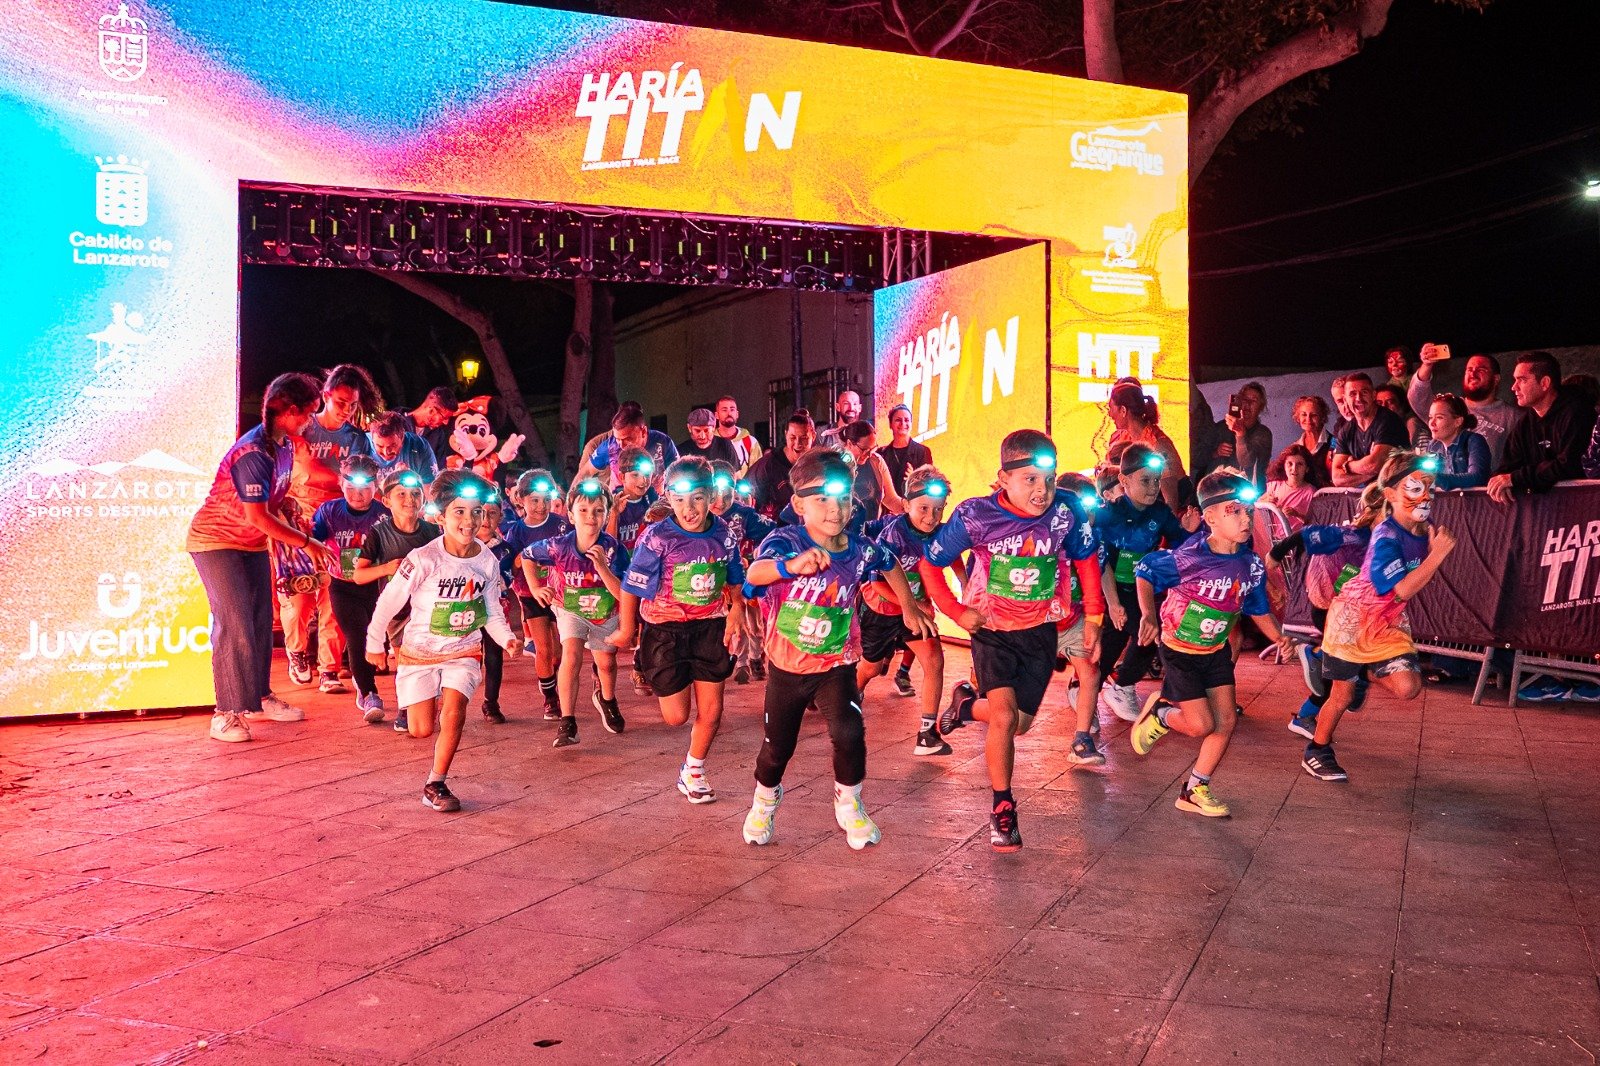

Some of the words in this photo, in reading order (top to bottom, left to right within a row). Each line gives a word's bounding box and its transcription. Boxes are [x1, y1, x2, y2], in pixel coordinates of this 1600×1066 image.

[579, 62, 705, 101] HARÍA
[68, 231, 145, 251] Cabildo
[148, 236, 173, 252] de
[73, 248, 170, 268] Lanzarote
[25, 480, 210, 500] LANZAROTE
[27, 505, 94, 518] SPORTS
[690, 573, 716, 591] 64
[1009, 567, 1041, 586] 62
[437, 578, 487, 601] TITAN
[578, 594, 602, 609] 57
[449, 610, 476, 627] 68
[798, 615, 833, 639] 50
[1199, 617, 1229, 634] 66
[19, 613, 214, 661] Juventud
